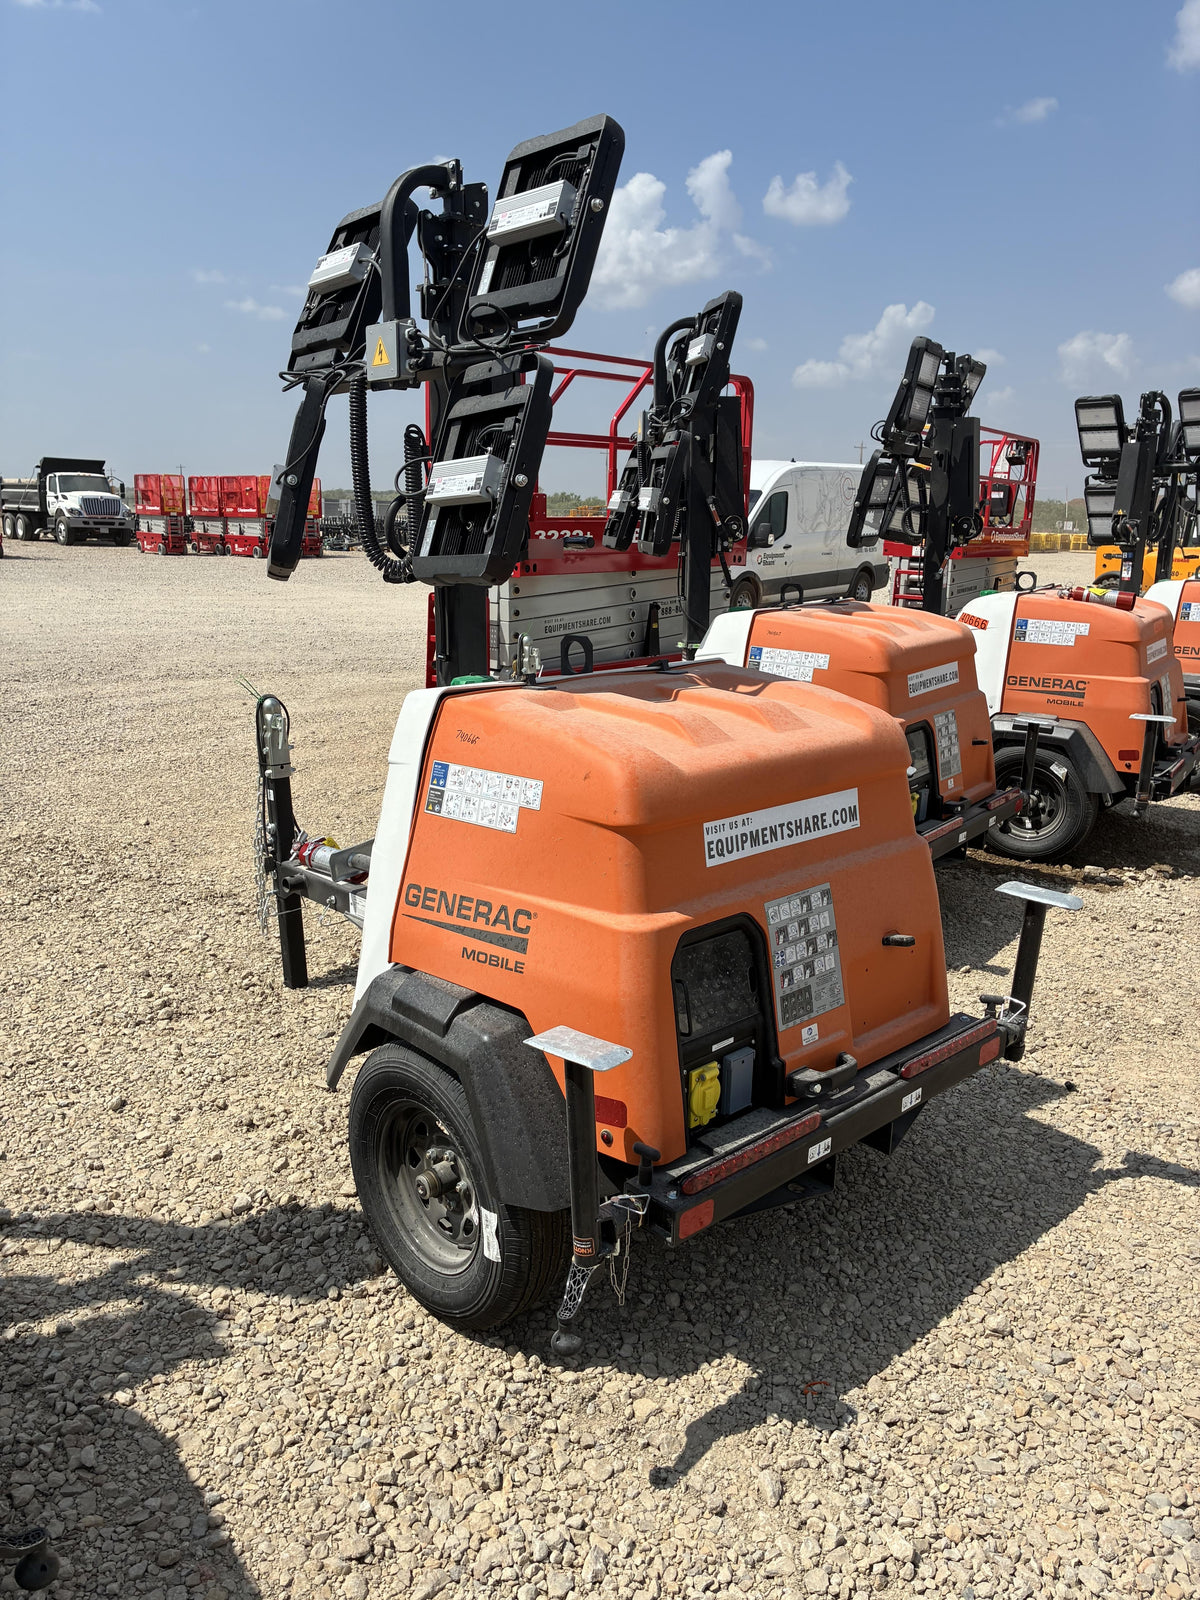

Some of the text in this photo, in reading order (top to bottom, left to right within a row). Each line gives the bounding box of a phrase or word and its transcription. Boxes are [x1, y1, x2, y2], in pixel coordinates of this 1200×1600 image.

[544, 615, 612, 634] EQUIPMENTSHARE.COM
[909, 670, 958, 694] EQUIPMENTSHARE.COM
[1006, 675, 1087, 691] GENERAC
[1046, 698, 1084, 707] MOBILE
[705, 817, 753, 836] VISIT US AT:
[707, 804, 858, 860] EQUIPMENTSHARE.COM
[404, 883, 533, 935] GENERAC
[461, 946, 526, 975] MOBILE
